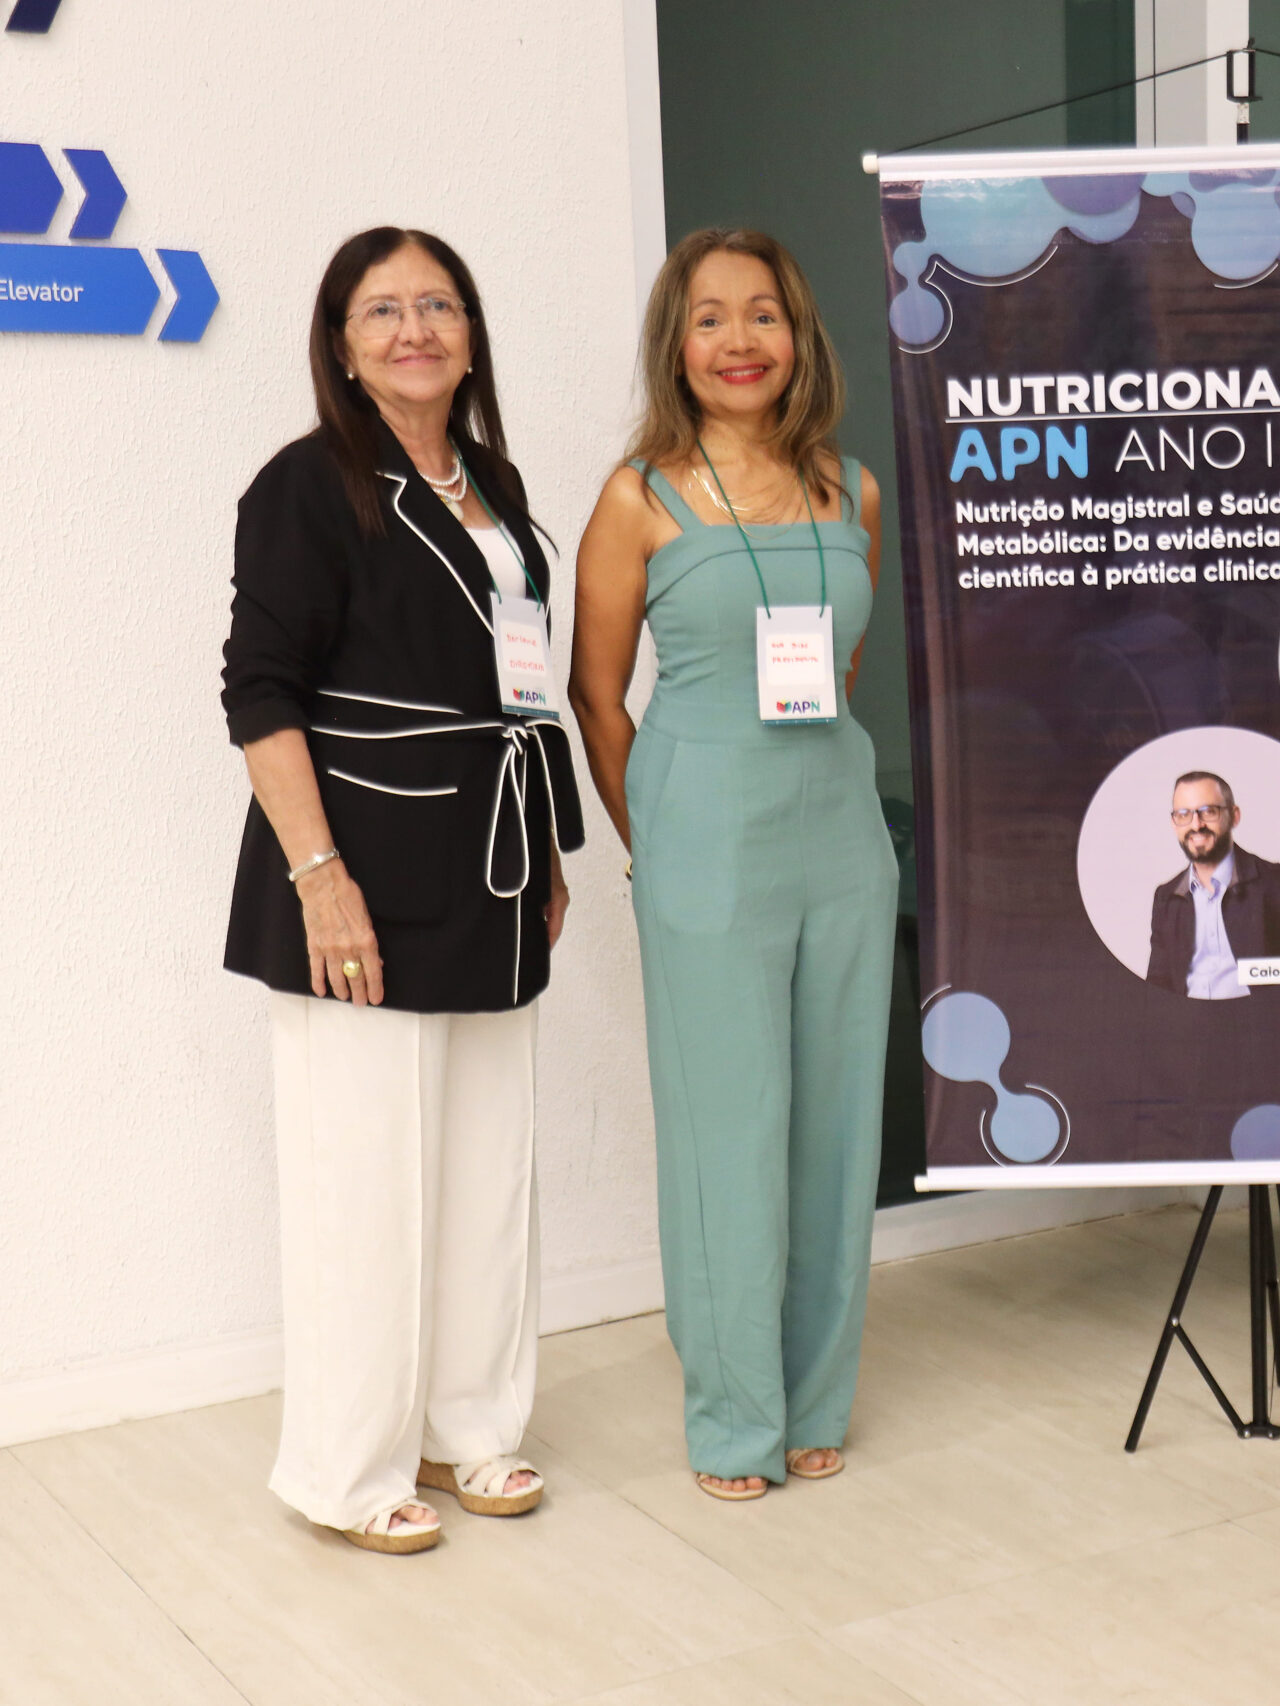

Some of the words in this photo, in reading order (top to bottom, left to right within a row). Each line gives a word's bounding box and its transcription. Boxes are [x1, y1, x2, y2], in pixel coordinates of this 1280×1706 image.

[0, 277, 84, 302] Elevator
[949, 425, 1089, 483] APN
[1115, 426, 1246, 473] ANO
[955, 499, 1065, 528] Nutrição
[1071, 494, 1190, 525] Magistral
[1197, 498, 1213, 516] e
[958, 529, 1107, 556] Metabólica:
[1114, 529, 1150, 552] Da
[1156, 525, 1280, 551] evidência
[958, 563, 1075, 589] científica
[1082, 562, 1099, 586] à
[1105, 561, 1197, 590] prática
[525, 691, 547, 706] APN
[792, 701, 820, 713] APN
[1249, 965, 1280, 978] Caio
